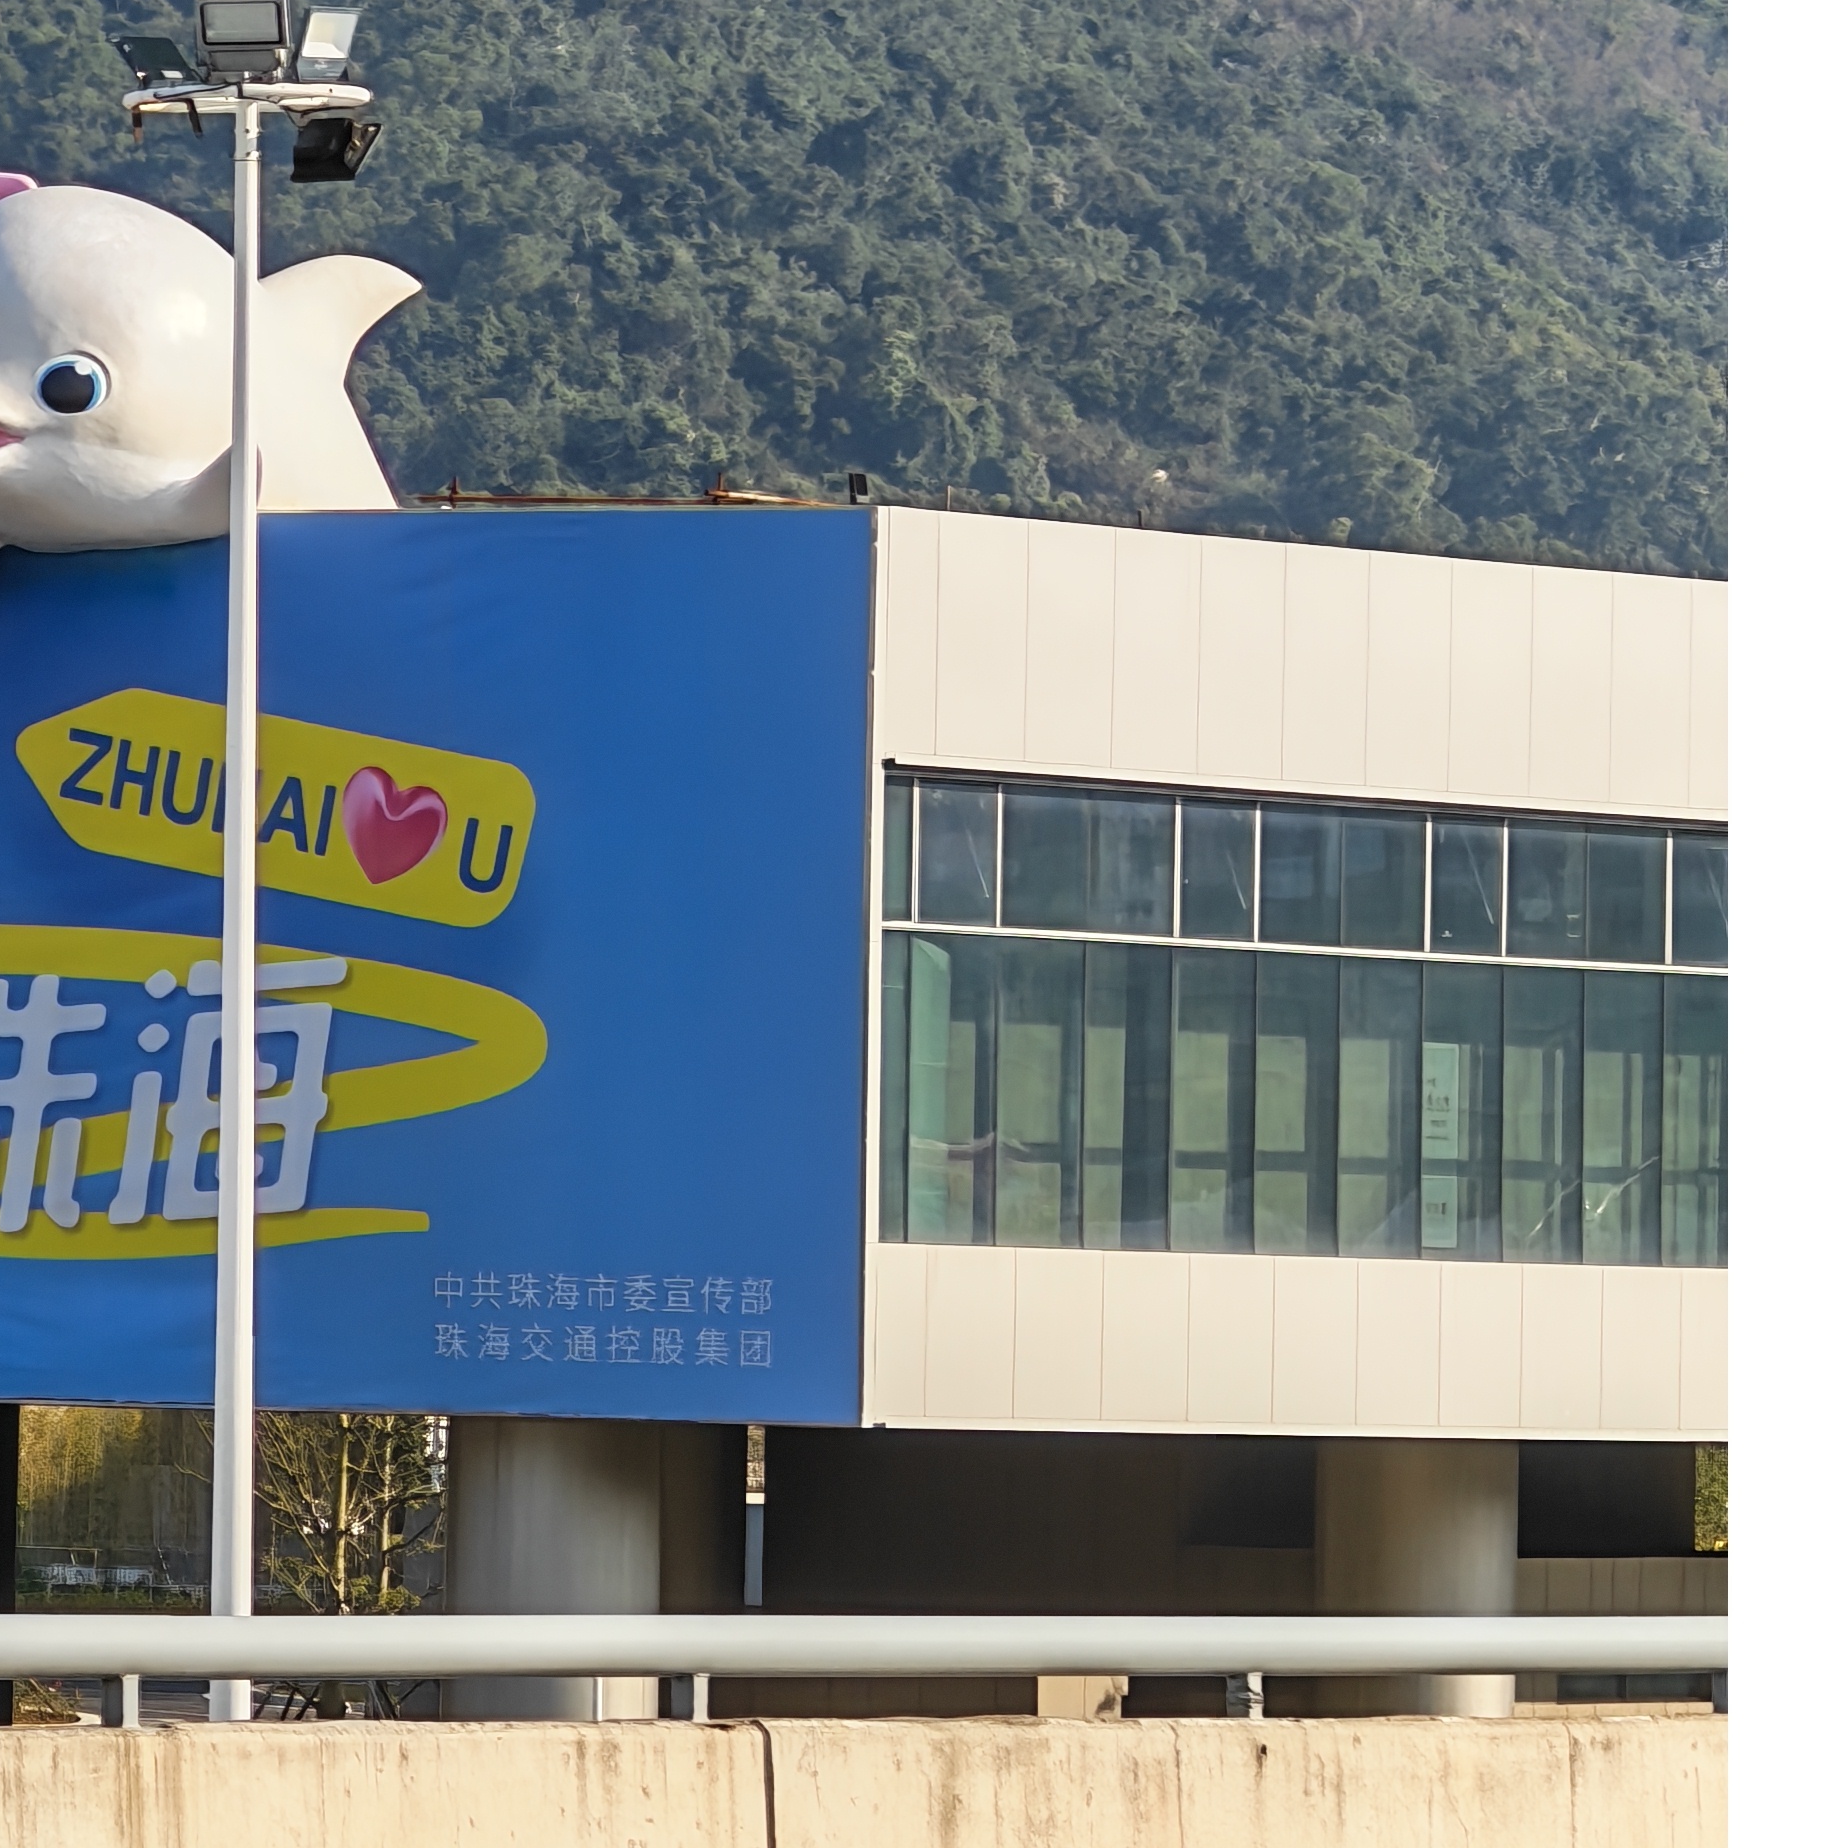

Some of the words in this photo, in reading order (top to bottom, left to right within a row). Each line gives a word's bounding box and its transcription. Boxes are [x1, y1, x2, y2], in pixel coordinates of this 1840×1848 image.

[459, 818, 514, 893] U
[434, 1272, 772, 1314] 中共珠海市委宣传部
[434, 1323, 772, 1368] 珠海交通控股集团
